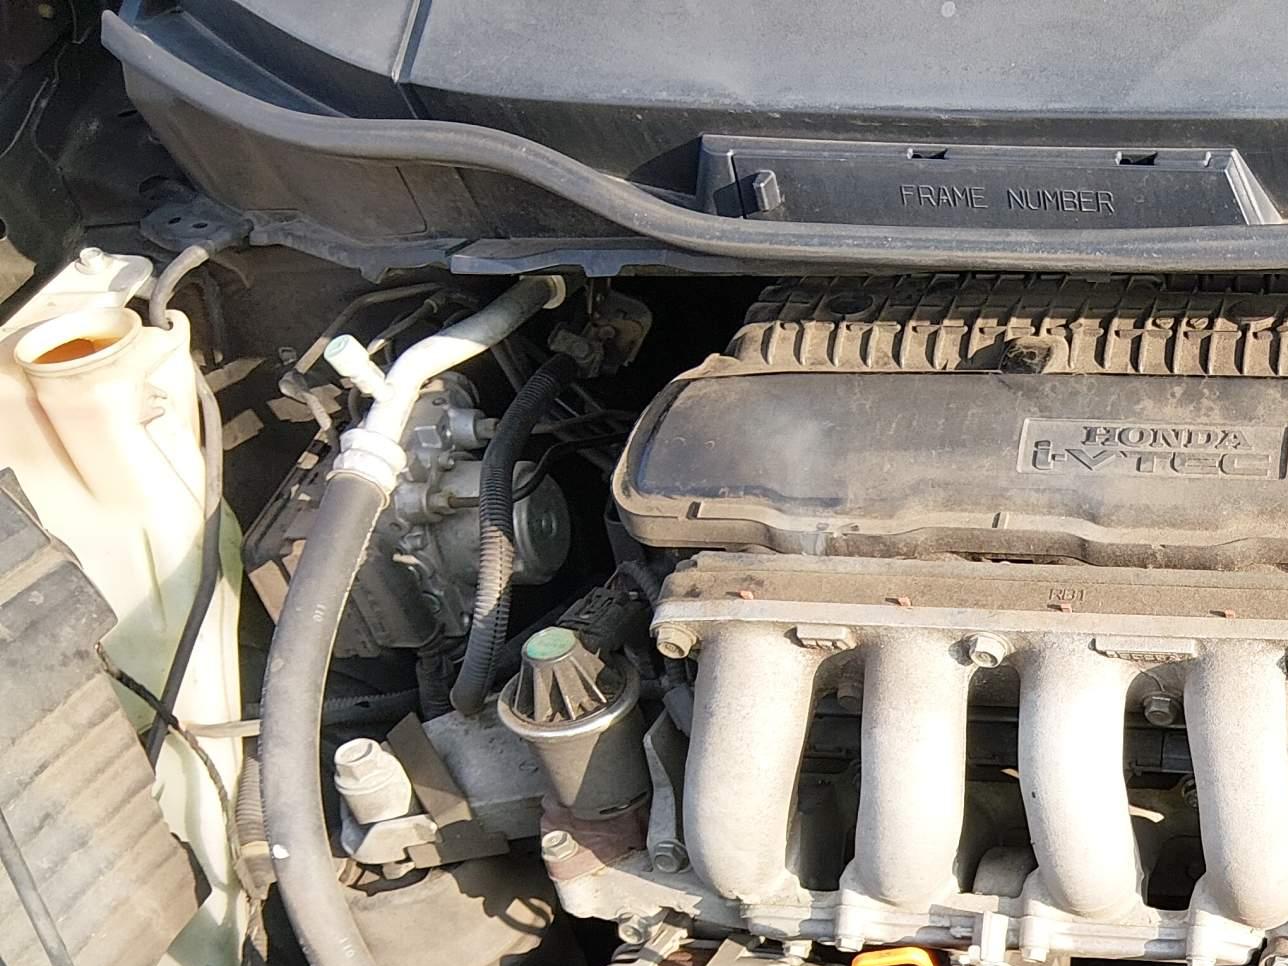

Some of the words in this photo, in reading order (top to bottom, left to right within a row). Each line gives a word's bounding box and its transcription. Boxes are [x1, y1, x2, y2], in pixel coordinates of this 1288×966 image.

[899, 184, 990, 209] FRAME
[1007, 186, 1116, 213] NUMBER
[1081, 425, 1252, 450] HONDA
[1032, 439, 1272, 477] i-VTEC
